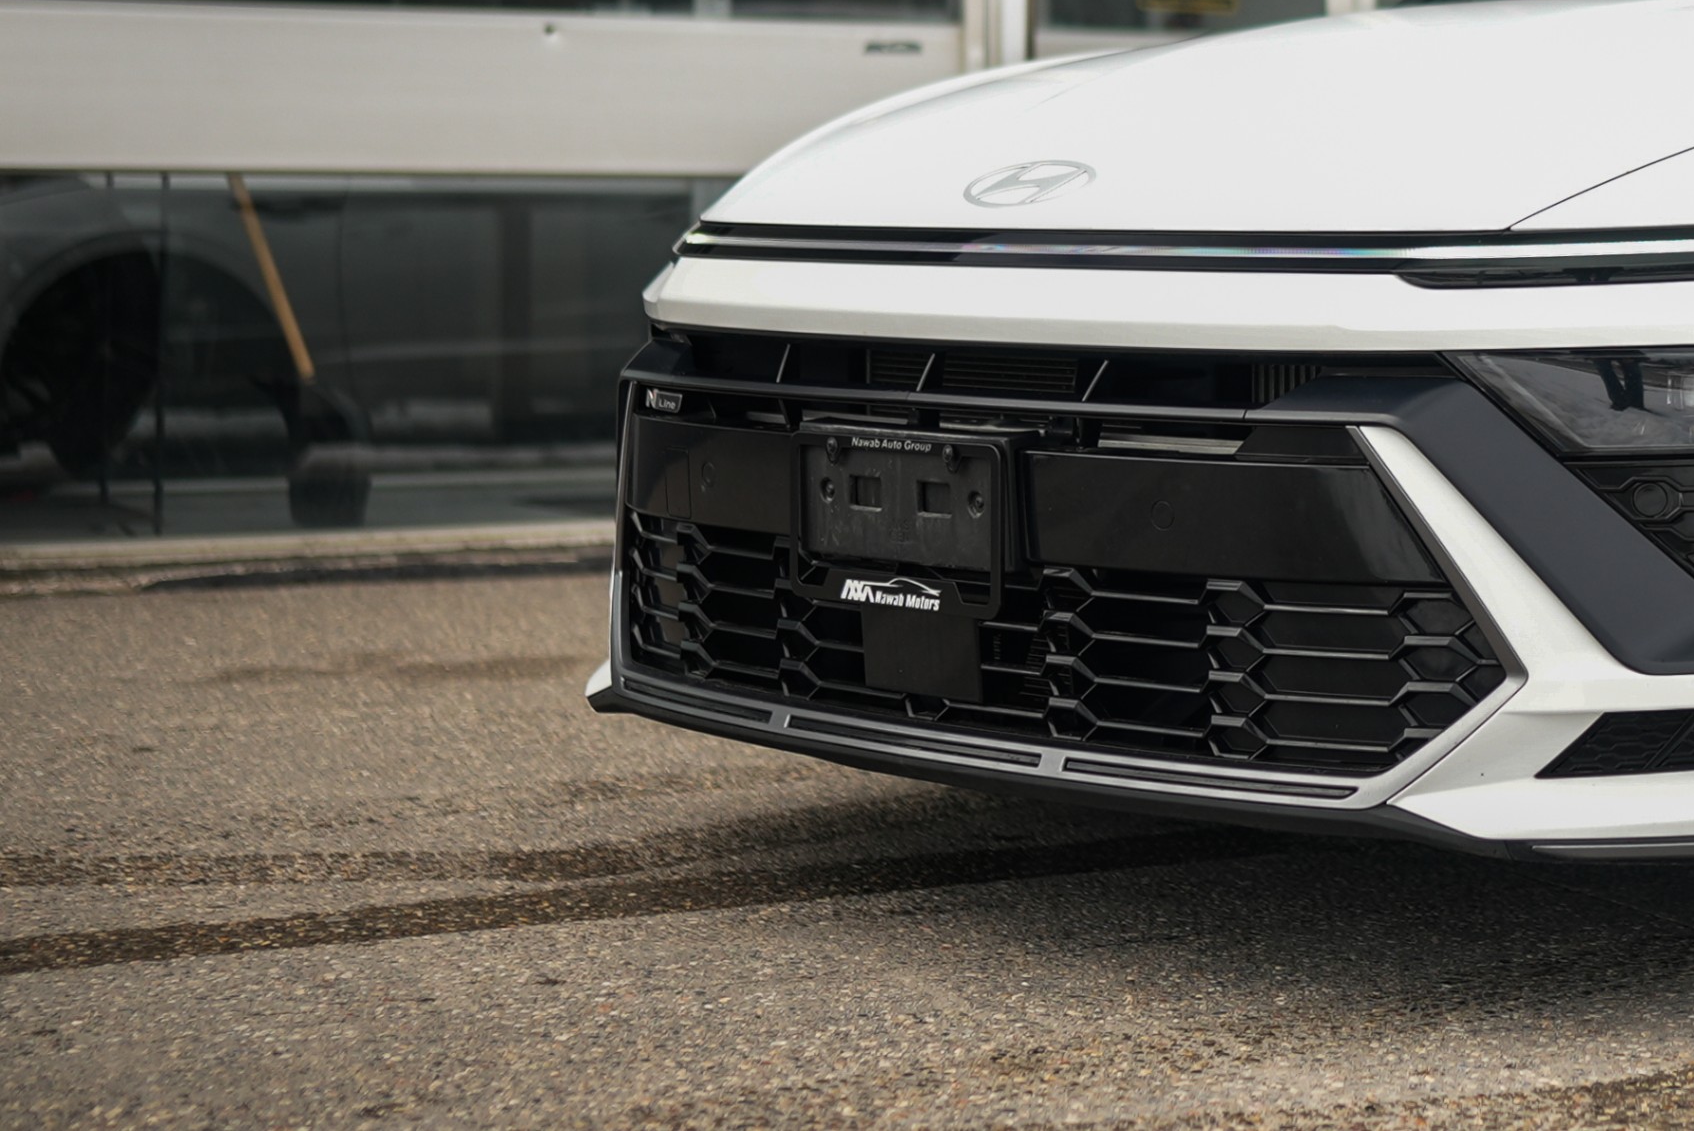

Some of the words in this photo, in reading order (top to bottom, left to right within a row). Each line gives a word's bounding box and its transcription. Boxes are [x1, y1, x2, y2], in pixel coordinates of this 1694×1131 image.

[659, 398, 676, 410] Line
[852, 436, 880, 448] Nawab
[881, 439, 903, 450] Auto
[904, 440, 932, 453] Group
[875, 590, 904, 607] Nawab
[905, 593, 940, 611] Motors
